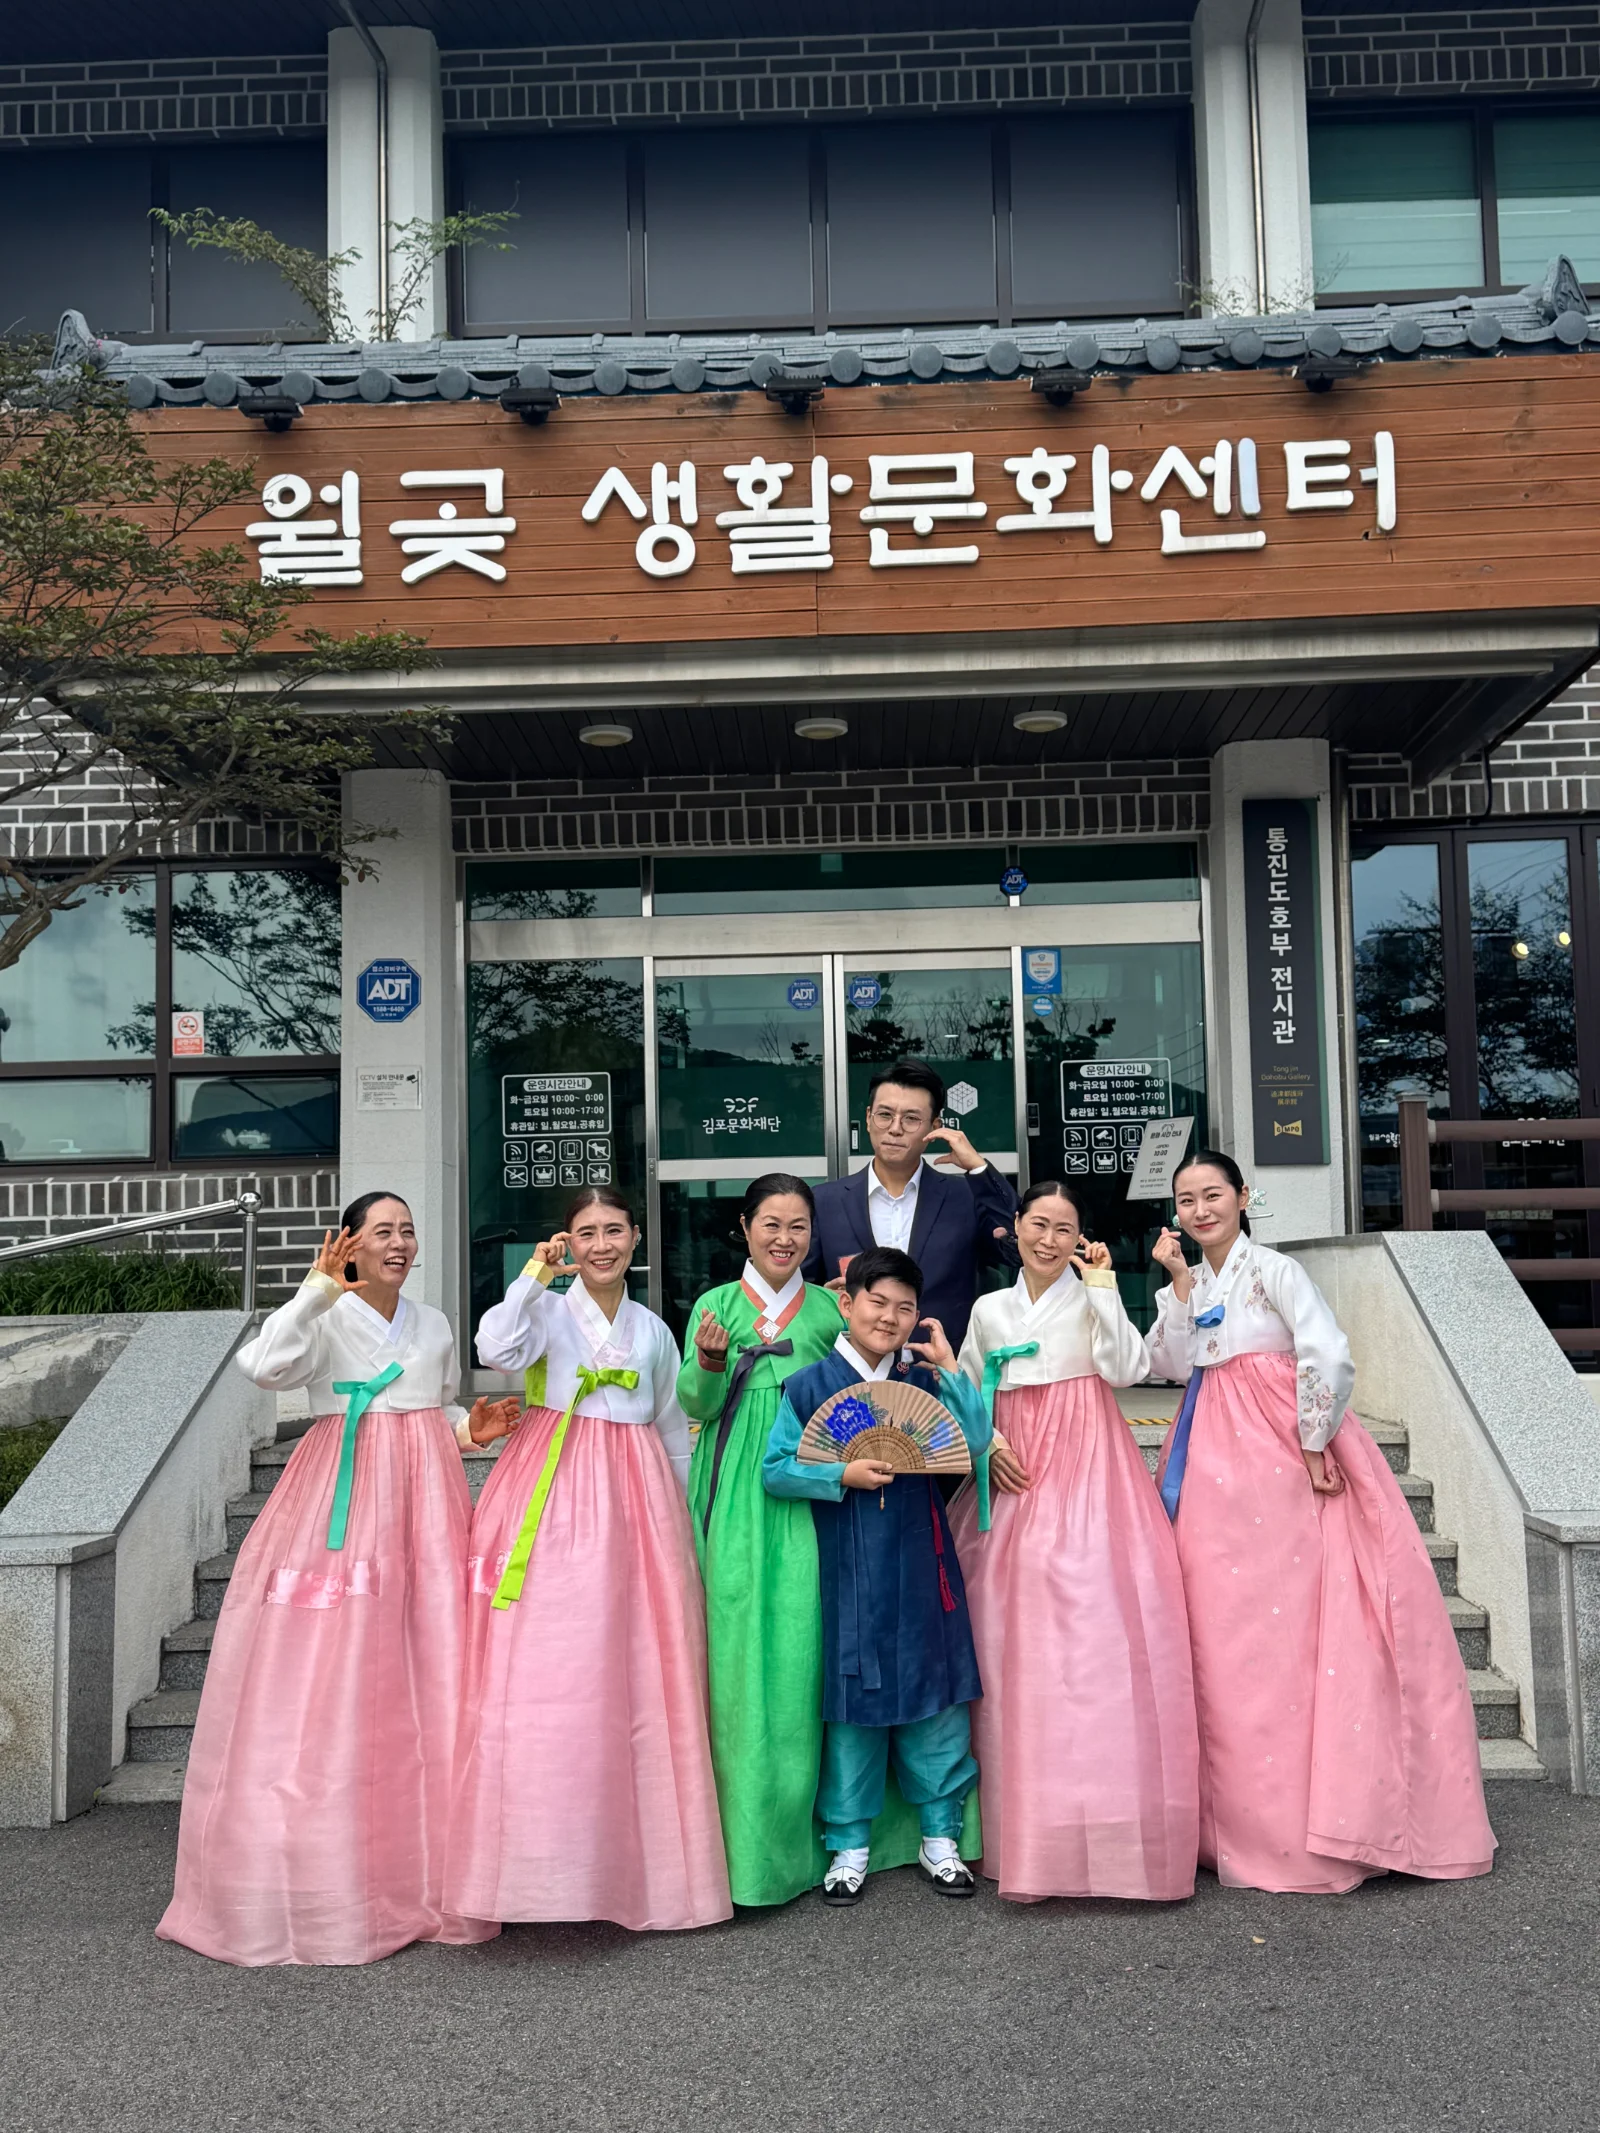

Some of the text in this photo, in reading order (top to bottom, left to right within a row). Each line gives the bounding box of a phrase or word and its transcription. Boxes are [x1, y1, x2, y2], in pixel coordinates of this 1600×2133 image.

[245, 430, 1396, 587] 월곶 생활문화센터
[1006, 874, 1024, 884] ADT
[1265, 827, 1296, 1044] 통진도호부 전시관
[367, 978, 411, 1000] ADT
[792, 988, 815, 1000] ADT
[853, 986, 876, 999] ADT
[1086, 1064, 1146, 1076] 운영시간안내
[527, 1079, 587, 1091] 운영시간안내
[1083, 1091, 1166, 1102] 토요일 10:00~17:00
[524, 1106, 605, 1117] 토요일 10:00~17:00
[1069, 1107, 1098, 1117] 휴관일:
[510, 1121, 539, 1132] 휴관일:
[702, 1116, 782, 1135] 김포문화재단
